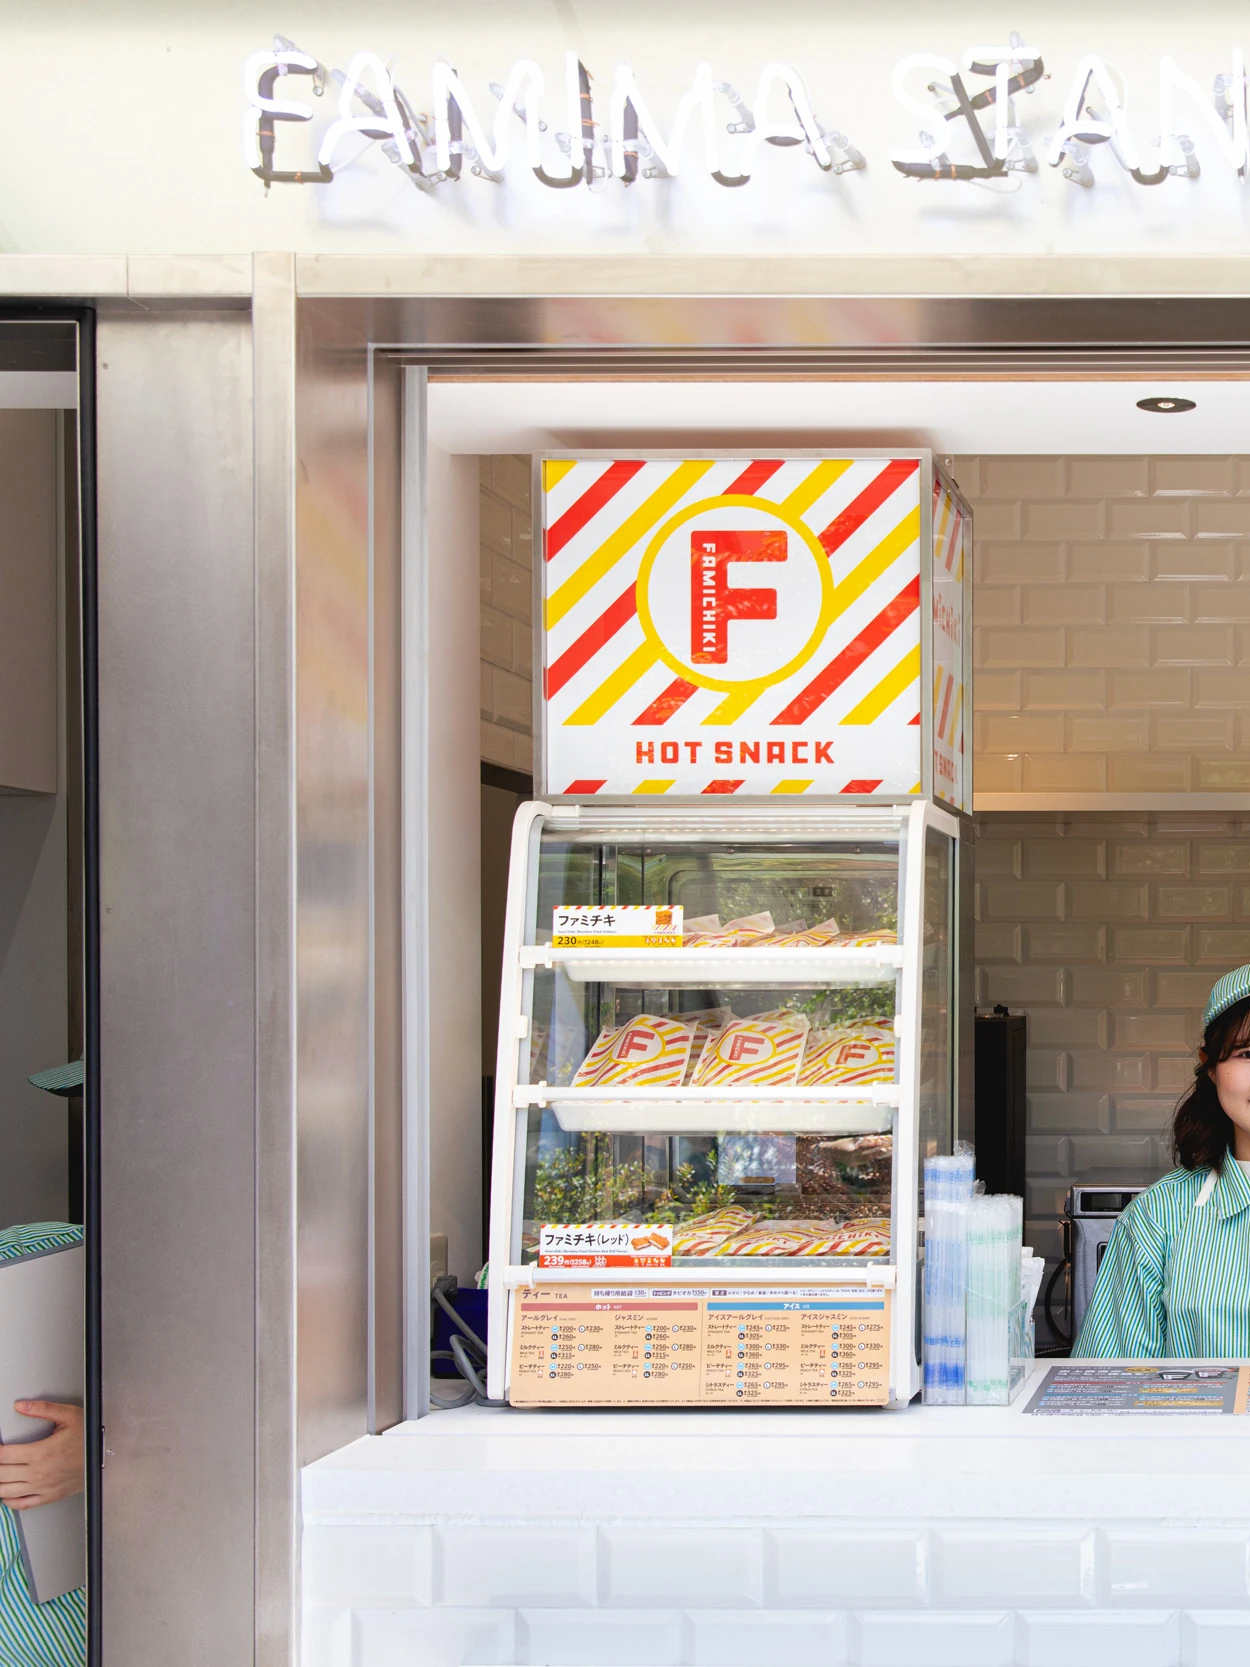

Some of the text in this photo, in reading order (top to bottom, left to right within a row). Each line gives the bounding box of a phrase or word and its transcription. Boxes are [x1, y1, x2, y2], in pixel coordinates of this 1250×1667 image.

[243, 49, 832, 180] FAMIMA
[690, 530, 788, 664] F
[702, 542, 716, 653] FAMICHIKI
[636, 741, 835, 764] HOT SNACK
[558, 914, 616, 927] ファミチキ
[545, 1233, 629, 1246] ファミチキ(レッド)
[522, 1289, 550, 1299] ティー
